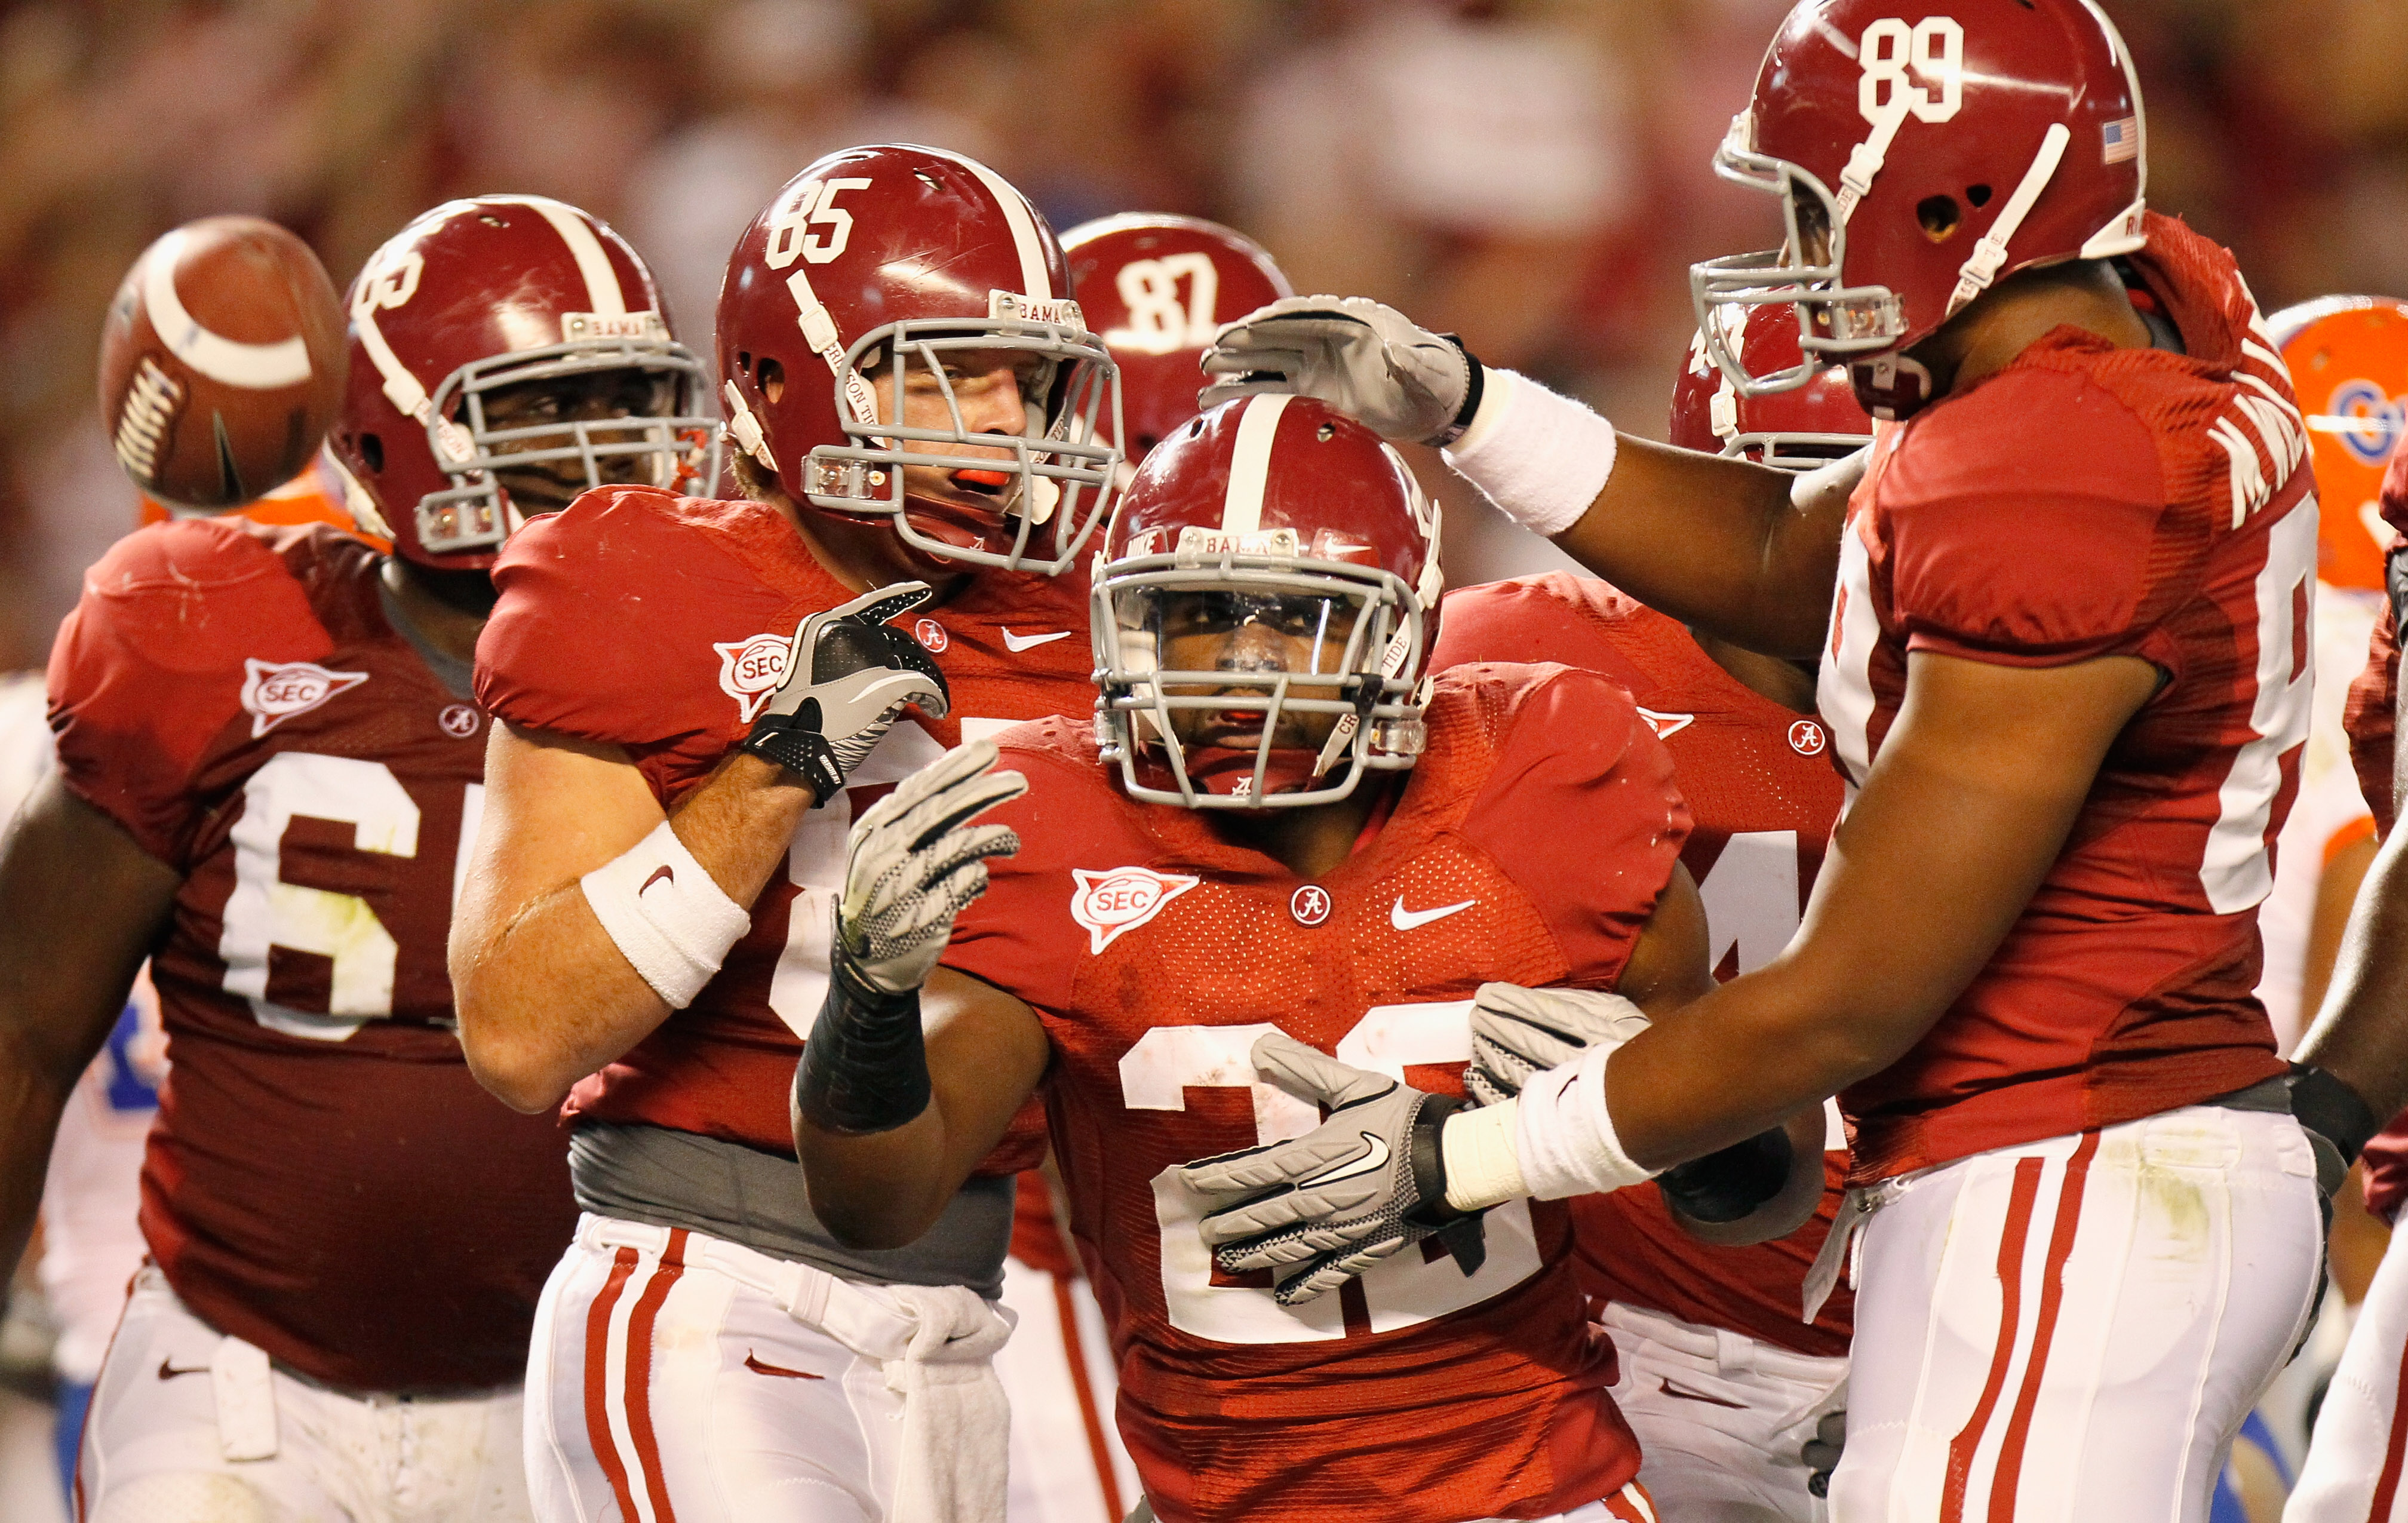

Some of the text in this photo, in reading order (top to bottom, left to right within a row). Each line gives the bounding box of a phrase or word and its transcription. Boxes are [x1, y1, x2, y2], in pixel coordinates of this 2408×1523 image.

[1859, 16, 1964, 123] 89
[765, 178, 872, 270] 85
[1019, 302, 1061, 324] BAMA
[1115, 251, 1218, 355] 87
[1126, 530, 1157, 557] NIKE
[1383, 636, 1407, 669] TIDE
[743, 655, 782, 680] SEC
[265, 684, 317, 702] SEC
[1794, 724, 1819, 748] A
[818, 754, 837, 777] VAPOR
[1096, 890, 1148, 911] SEC
[1297, 891, 1323, 918] A
